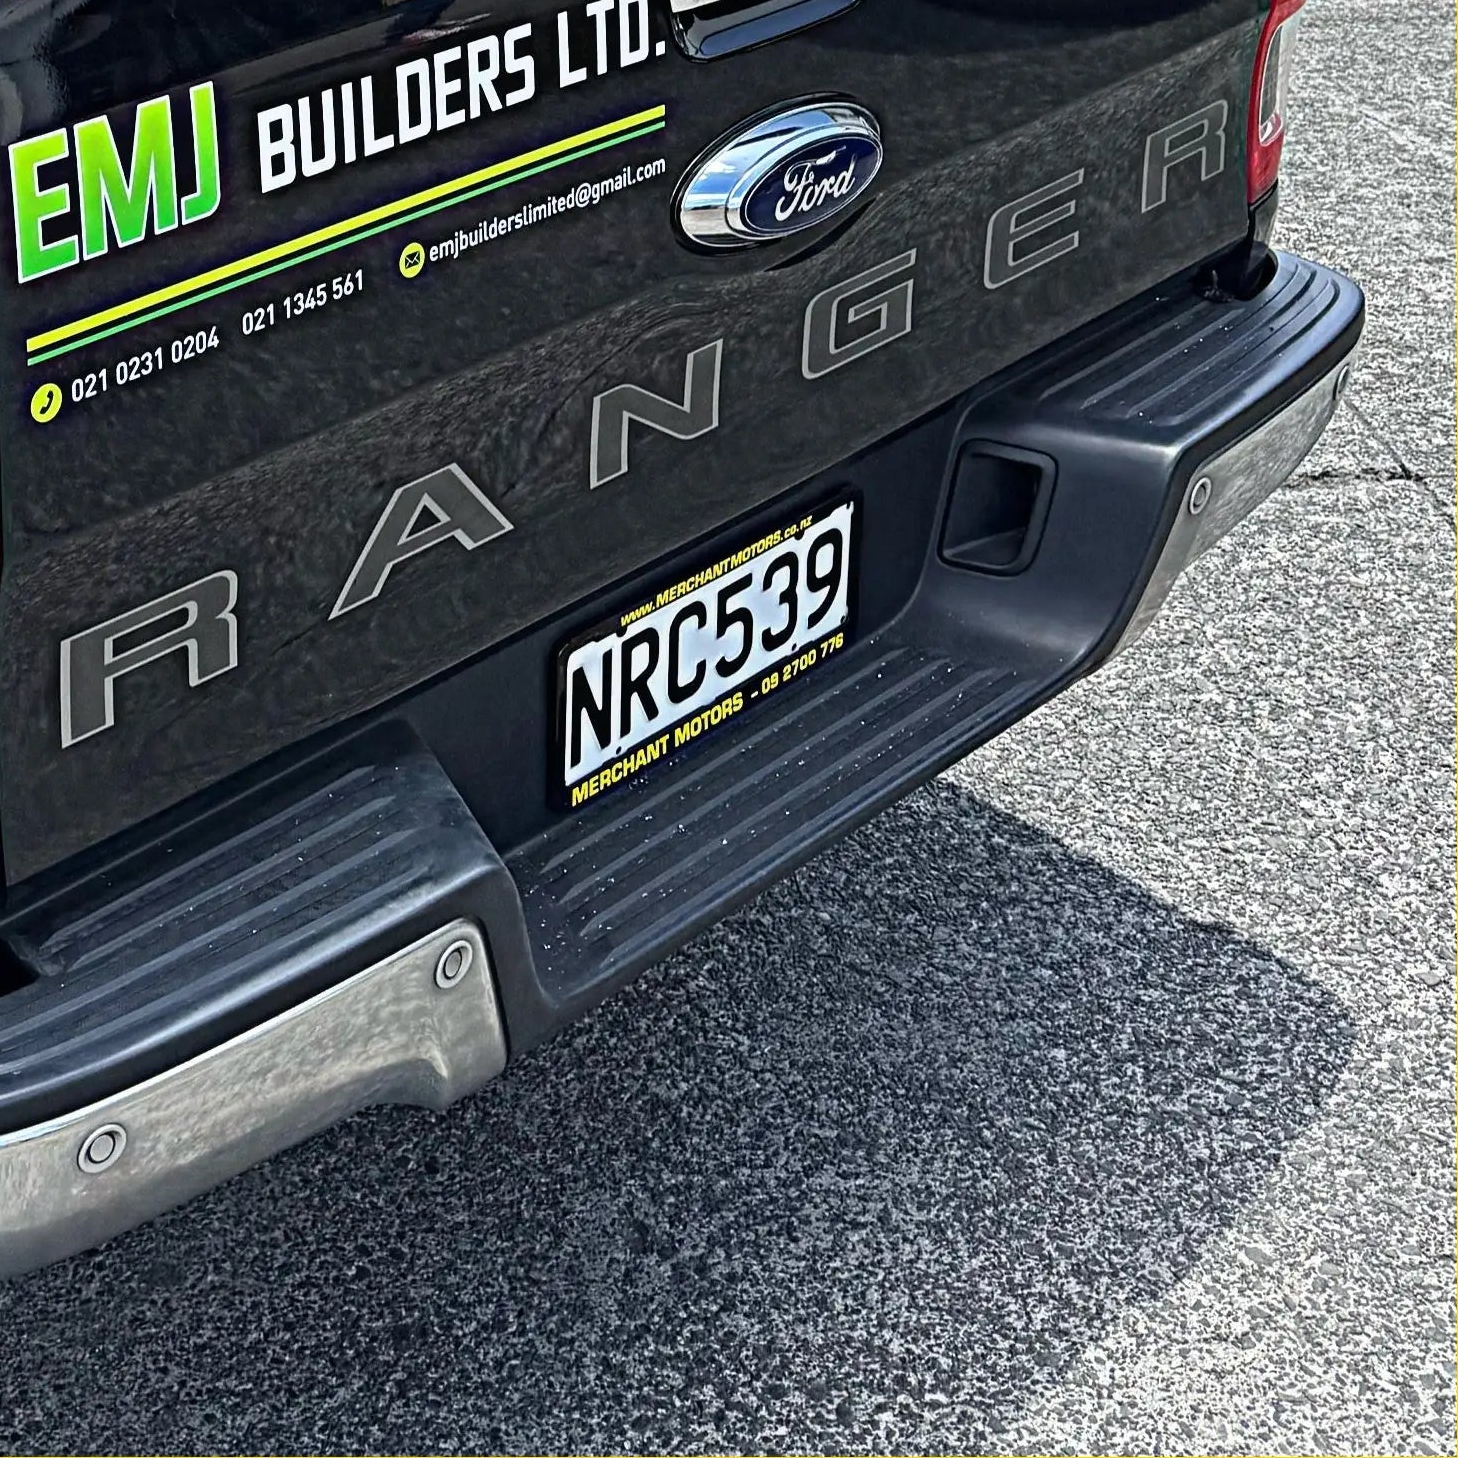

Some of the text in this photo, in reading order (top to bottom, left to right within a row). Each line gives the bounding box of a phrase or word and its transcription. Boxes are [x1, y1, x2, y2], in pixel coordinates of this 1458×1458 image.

[7, 80, 222, 285] EMJ
[256, 23, 536, 194] BUILDERS
[428, 156, 667, 264] emjbuilderslimited@gmail.com
[774, 147, 858, 222] Ford
[70, 268, 365, 404] 021 0231 0204 021 1345 561
[59, 98, 1230, 748] RANGER
[569, 527, 844, 769] NRC539
[619, 515, 813, 627] www.MERCHANTMOTORS.co.nz
[571, 737, 670, 808] MERCHANT
[674, 691, 744, 747] MOTORS
[761, 672, 780, 696] 09
[782, 646, 817, 682] 2700
[819, 631, 845, 660] 776
